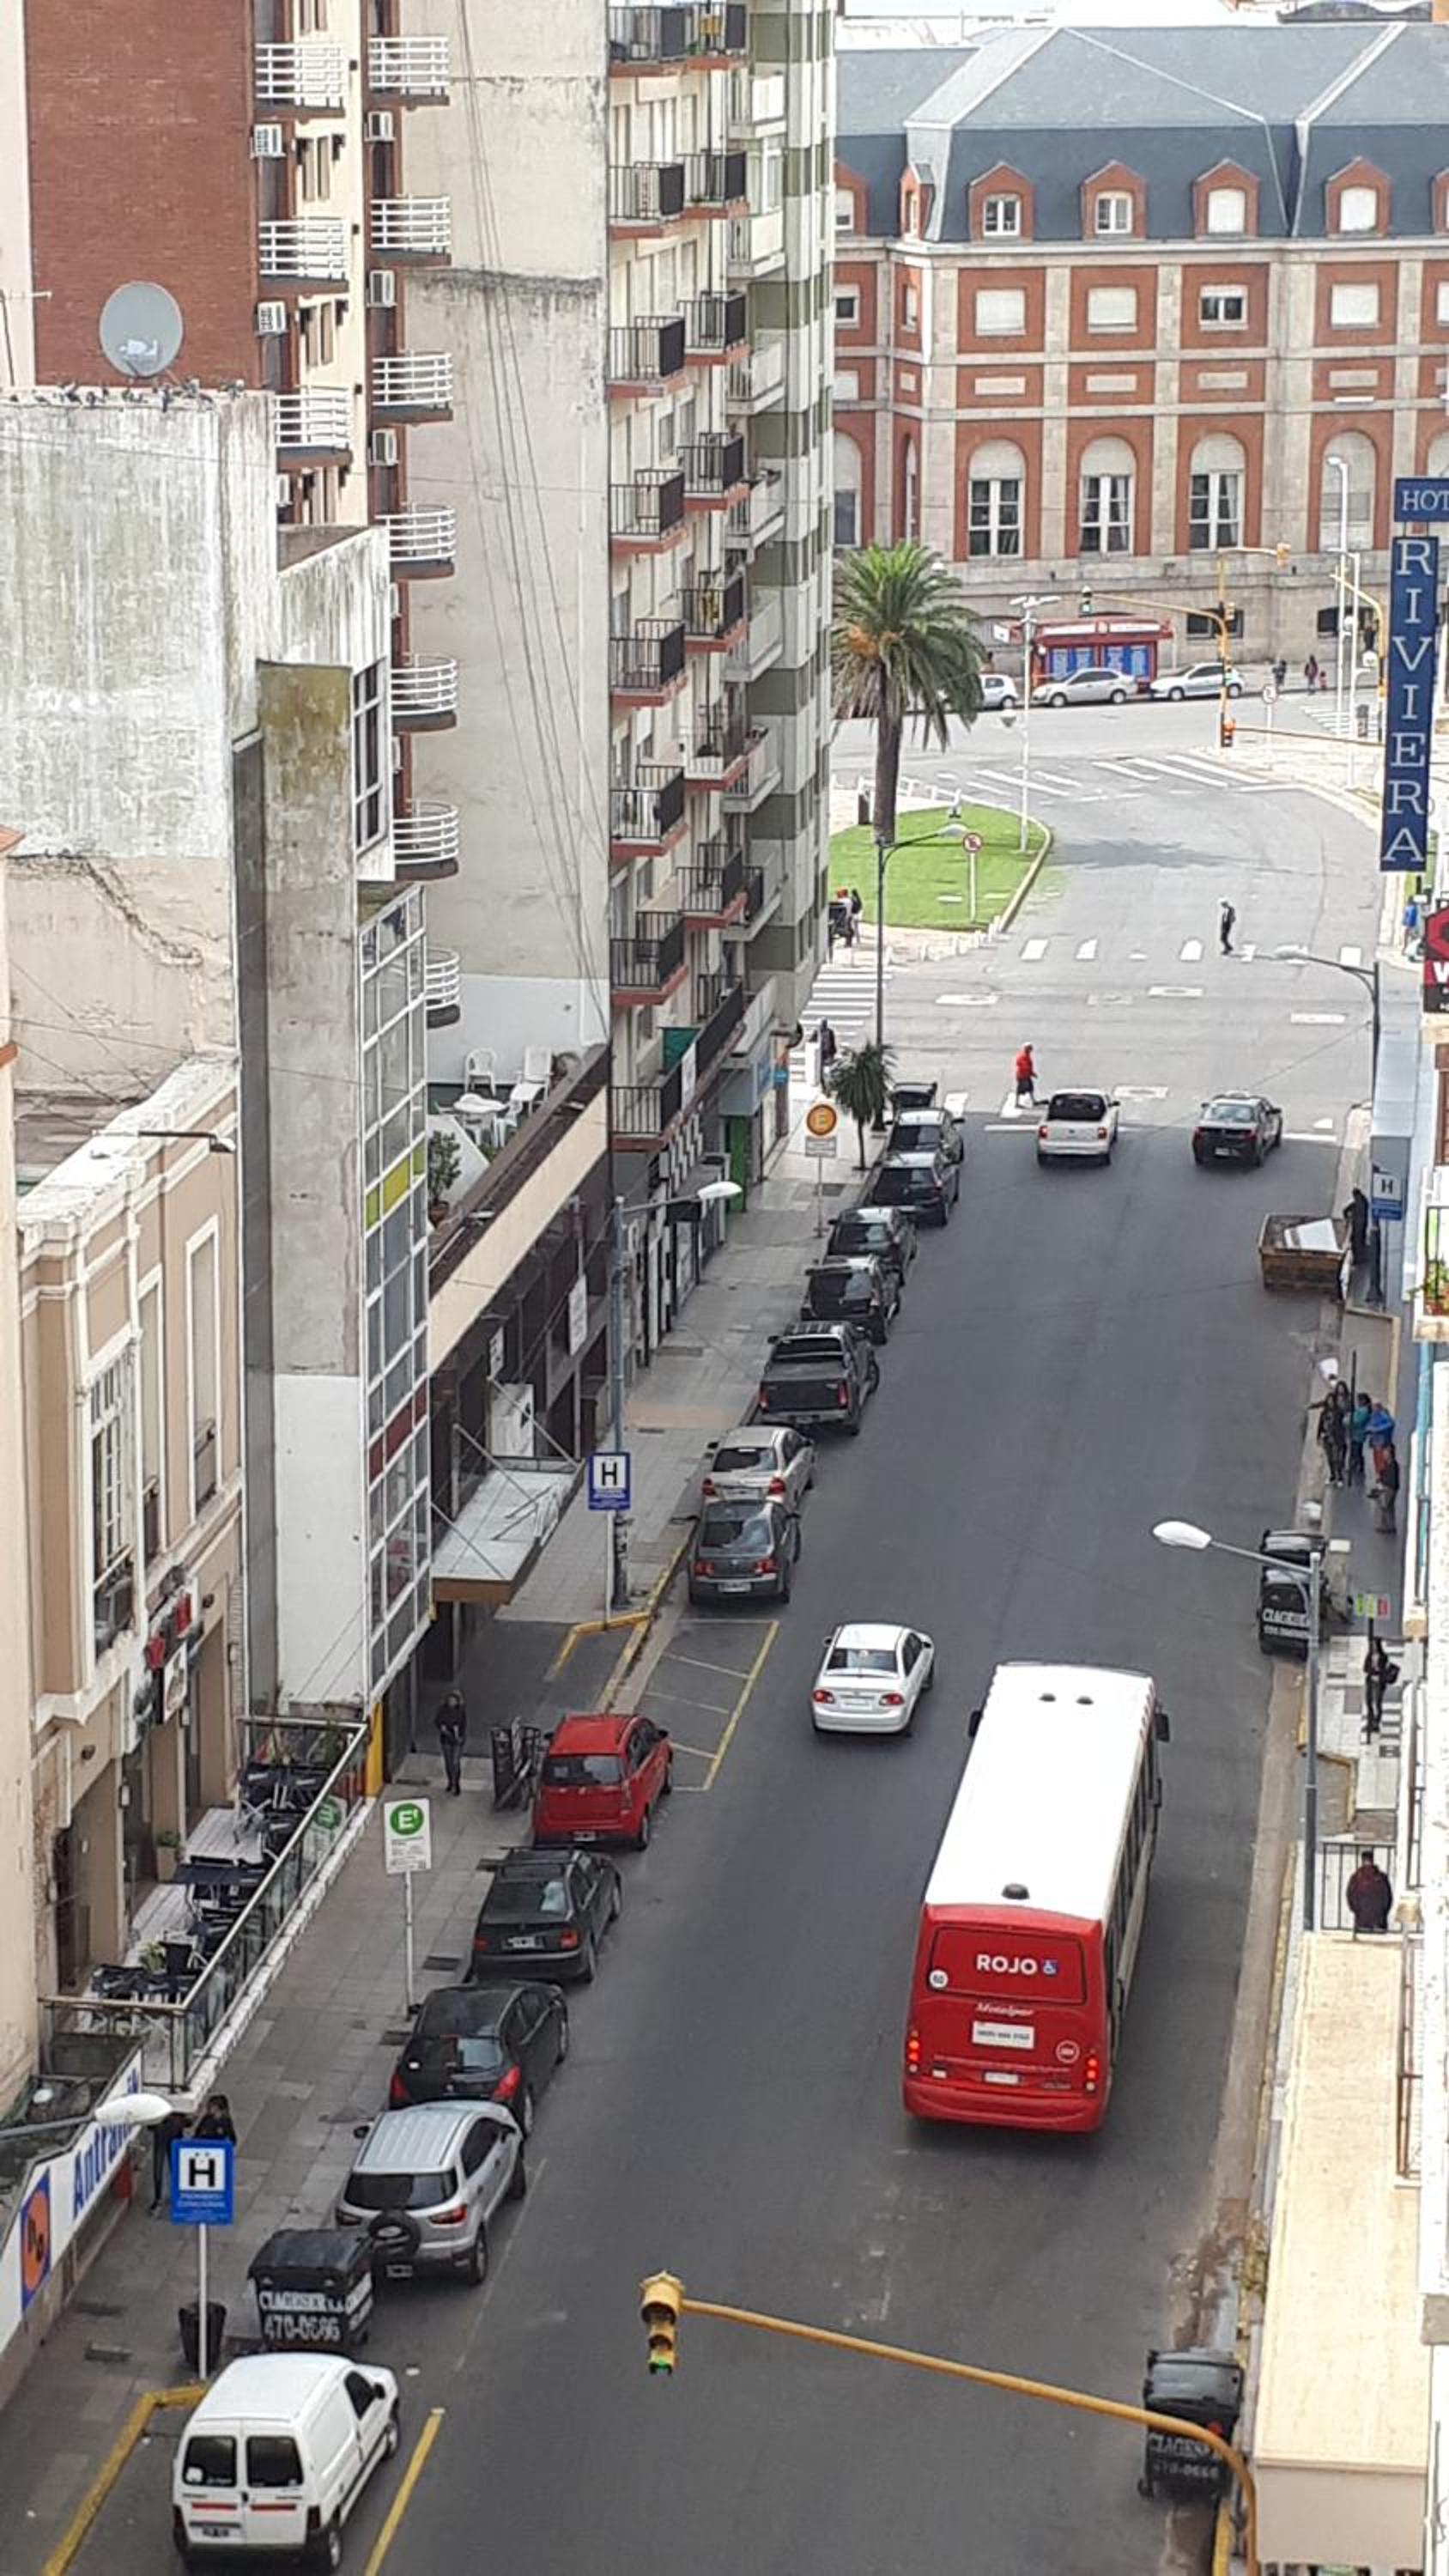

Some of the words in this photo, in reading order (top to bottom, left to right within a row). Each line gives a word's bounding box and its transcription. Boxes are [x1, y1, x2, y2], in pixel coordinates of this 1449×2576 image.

[1382, 540, 1434, 863] RIVIERA
[602, 1461, 617, 1486] H
[977, 1953, 1038, 1975] ROJO
[190, 2158, 215, 2187] H
